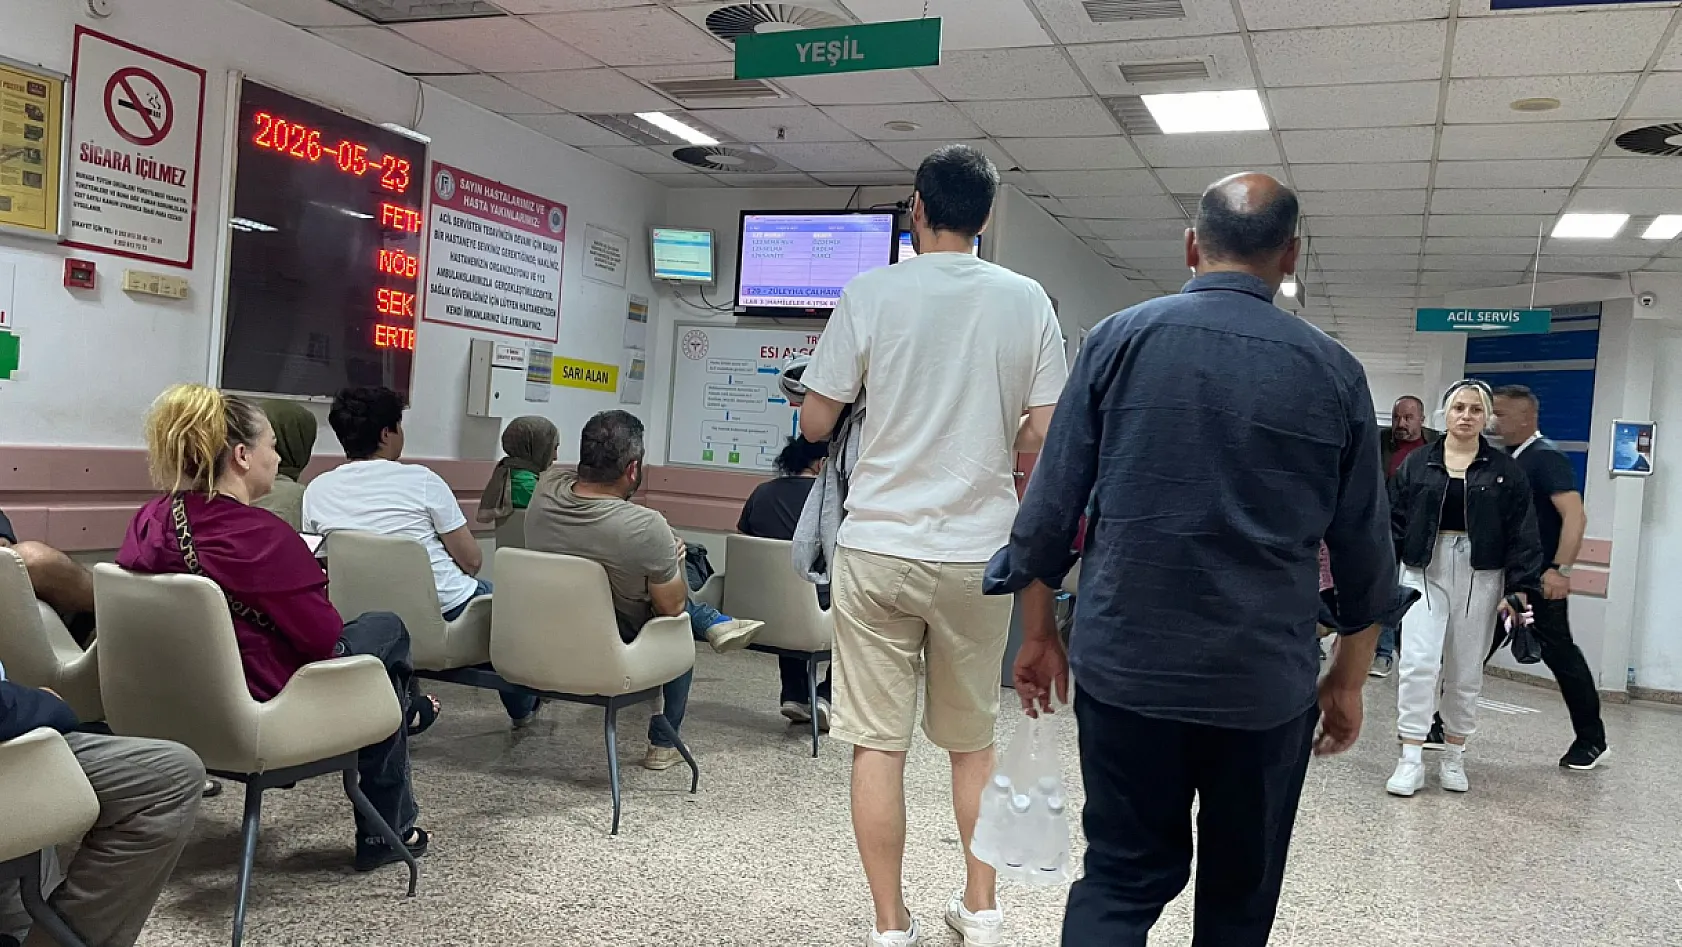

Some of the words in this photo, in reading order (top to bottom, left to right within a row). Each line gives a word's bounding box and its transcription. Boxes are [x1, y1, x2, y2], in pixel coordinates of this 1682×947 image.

[796, 35, 864, 66] YEŞİL
[255, 112, 411, 192] 2026-05-23
[80, 140, 131, 174] SİGARA
[136, 152, 186, 188] İÇİLMEZ
[459, 177, 483, 195] SAYIN
[463, 195, 489, 213] HASTA
[378, 250, 417, 278] NÖB
[376, 288, 414, 317] SEK
[1447, 309, 1474, 322] ACİL
[1477, 309, 1520, 323] SERVİS
[760, 346, 778, 359] ESI
[563, 365, 584, 382] SARI
[585, 367, 609, 384] ALAN
